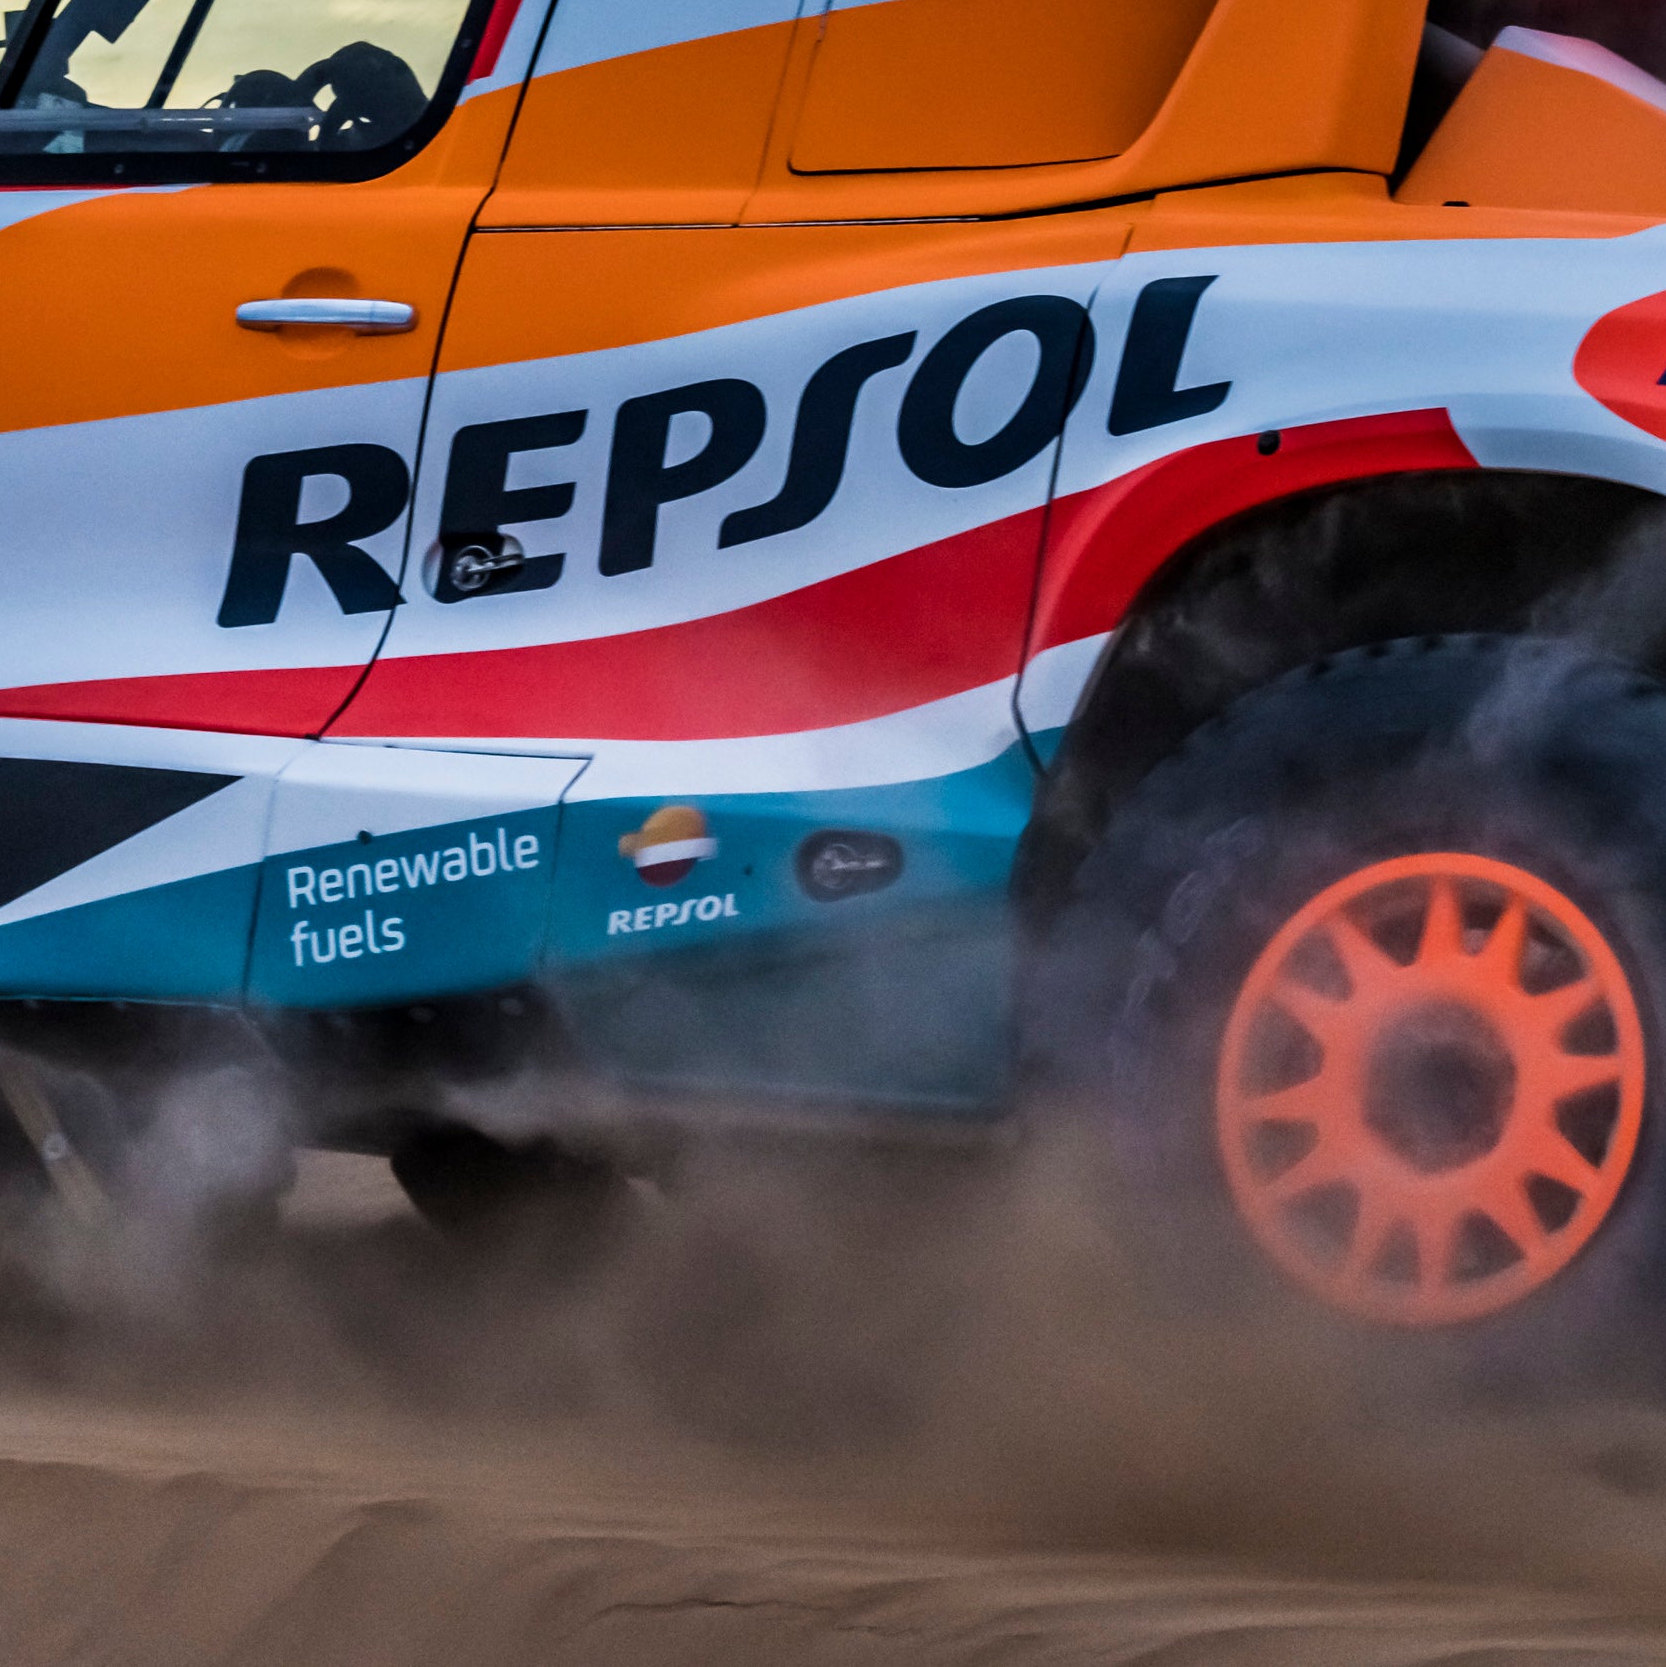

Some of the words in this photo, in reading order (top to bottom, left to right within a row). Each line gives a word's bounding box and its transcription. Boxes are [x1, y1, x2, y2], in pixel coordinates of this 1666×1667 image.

[217, 274, 1233, 628] REPSOL
[285, 828, 540, 909] Renewable
[290, 908, 406, 967] fuels
[606, 891, 740, 936] REPSOL
